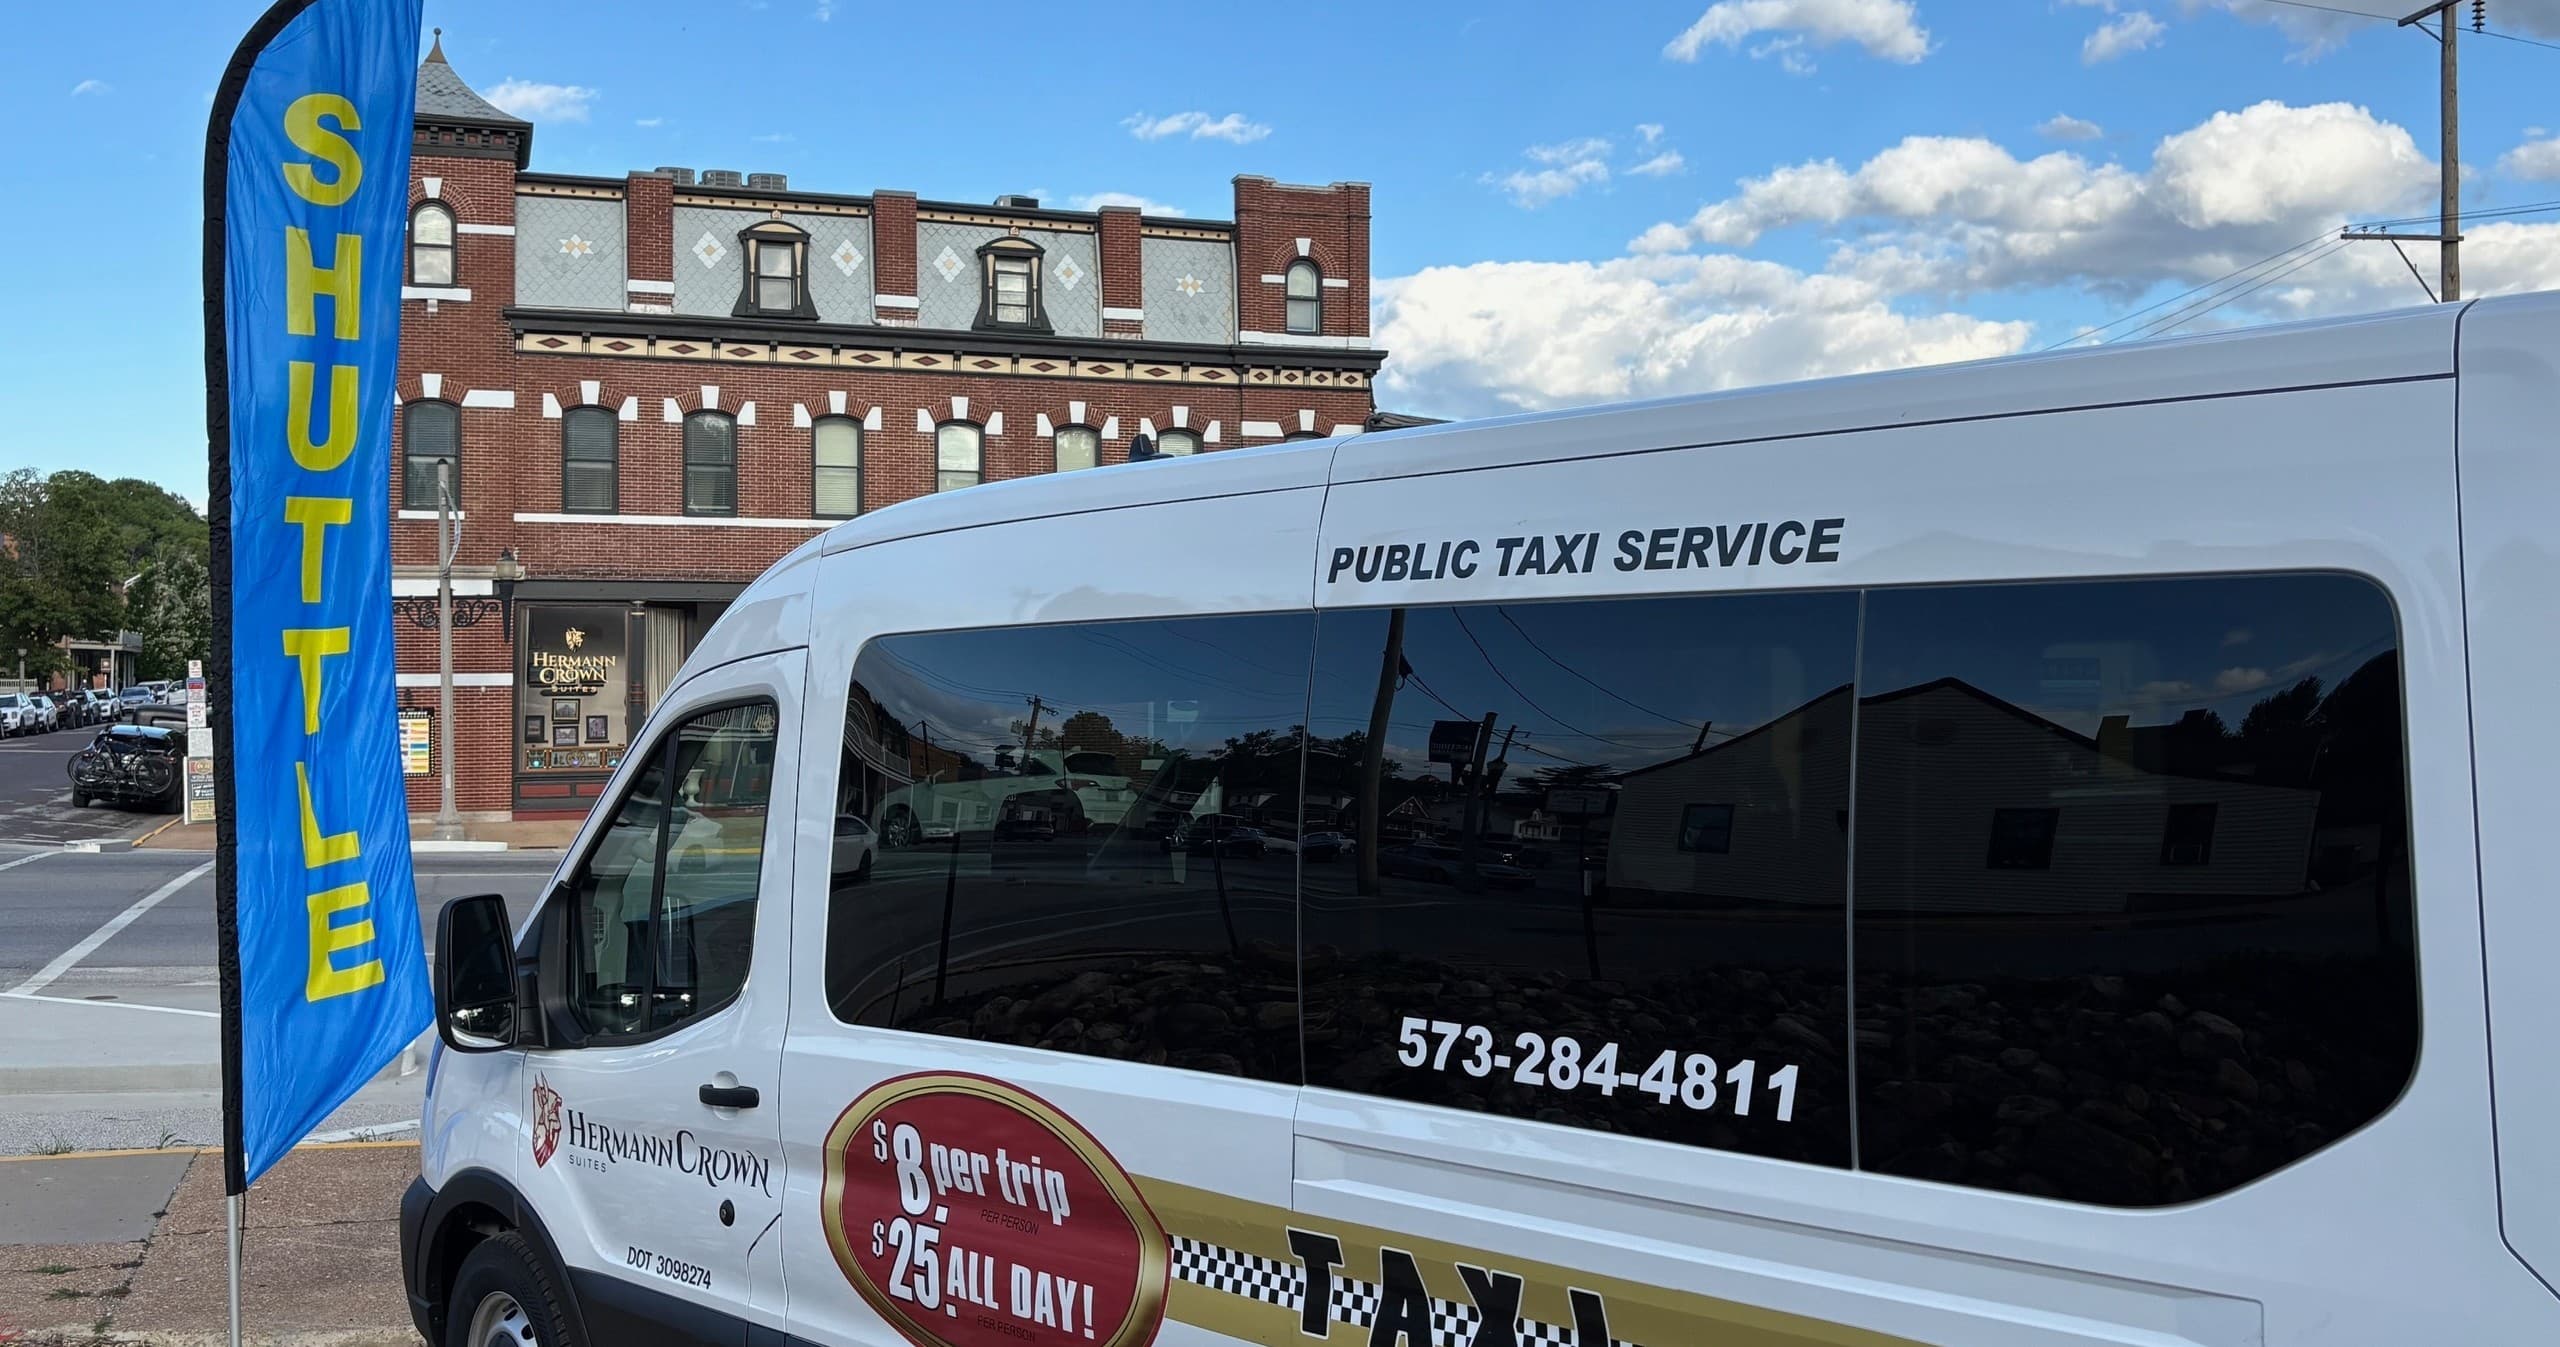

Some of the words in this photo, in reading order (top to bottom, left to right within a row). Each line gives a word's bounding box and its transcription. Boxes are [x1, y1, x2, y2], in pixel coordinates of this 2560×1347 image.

[283, 94, 385, 1001] SHUTTLE
[1328, 541, 1480, 584] PUBLIC
[1496, 533, 1600, 577] TAXI
[1613, 518, 1845, 572] SERVICE
[533, 652, 616, 668] HERMANN
[539, 667, 608, 684] CROWN
[1398, 1016, 1799, 1122] 573-284-4811
[569, 1154, 607, 1173] SUITES
[930, 1142, 990, 1196] per
[996, 1148, 1071, 1226] trip
[980, 1209, 999, 1224] PER
[1001, 1213, 1040, 1235] PERSON
[626, 1246, 653, 1270] DOT
[656, 1255, 711, 1290] 3098274
[947, 1246, 999, 1310] ALL
[1011, 1263, 1095, 1340] DAY!
[977, 1315, 996, 1331] PER
[997, 1320, 1036, 1342] PERSON
